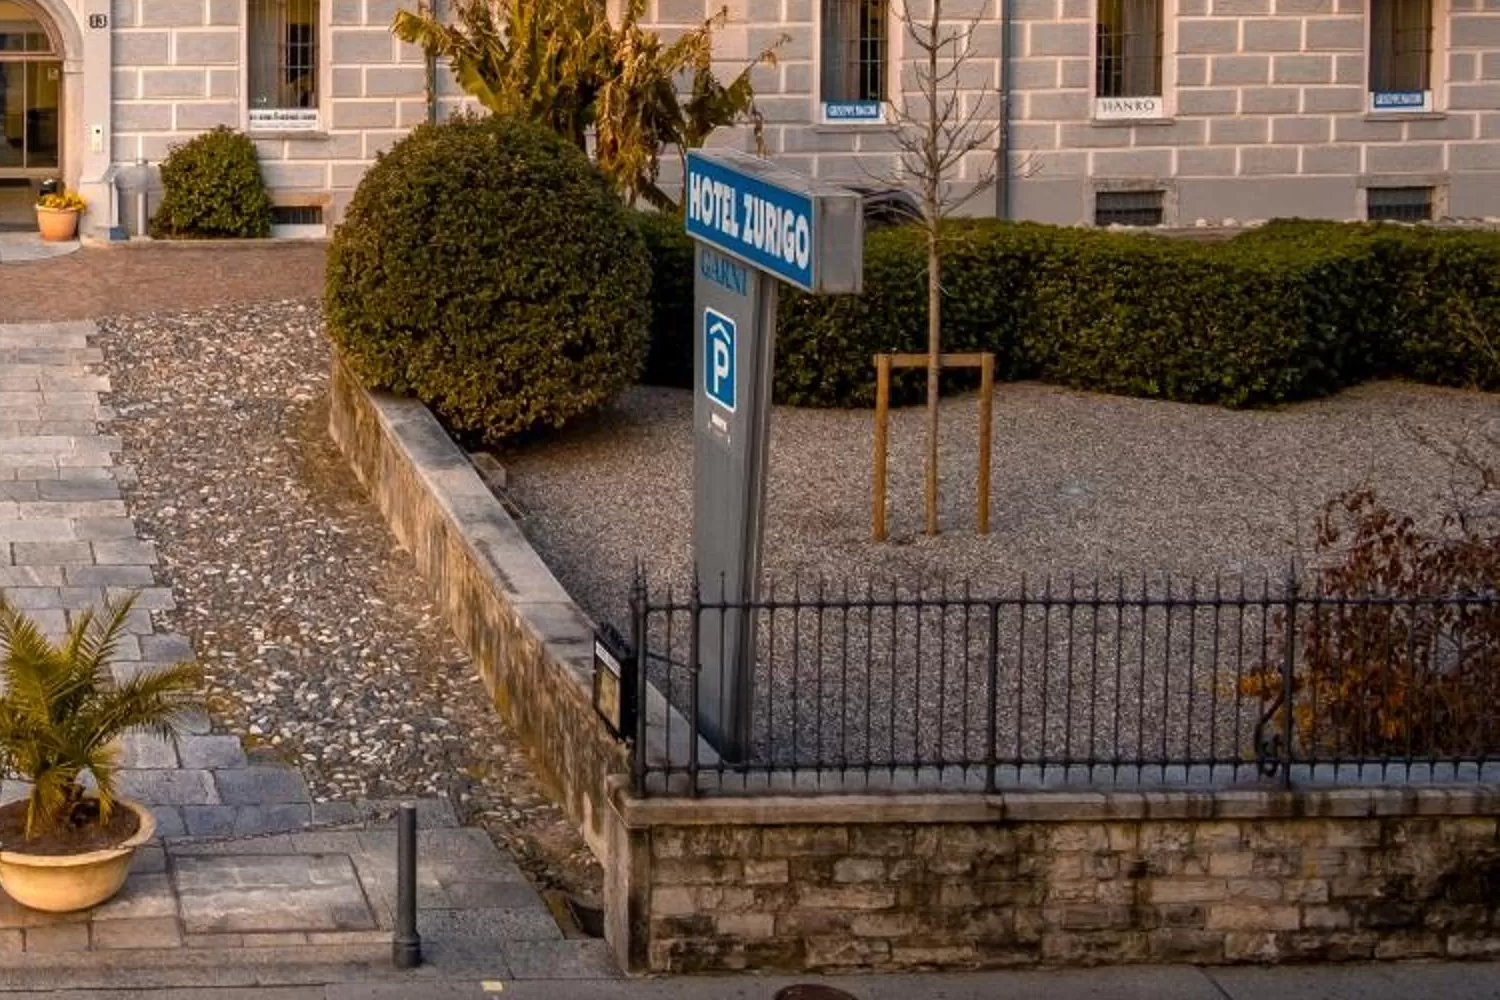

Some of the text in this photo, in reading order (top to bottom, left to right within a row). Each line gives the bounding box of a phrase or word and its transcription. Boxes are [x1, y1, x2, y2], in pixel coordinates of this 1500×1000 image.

[1102, 100, 1155, 112] HANRO
[689, 171, 811, 270] HOTEL ZURIGO
[713, 337, 729, 394] P
